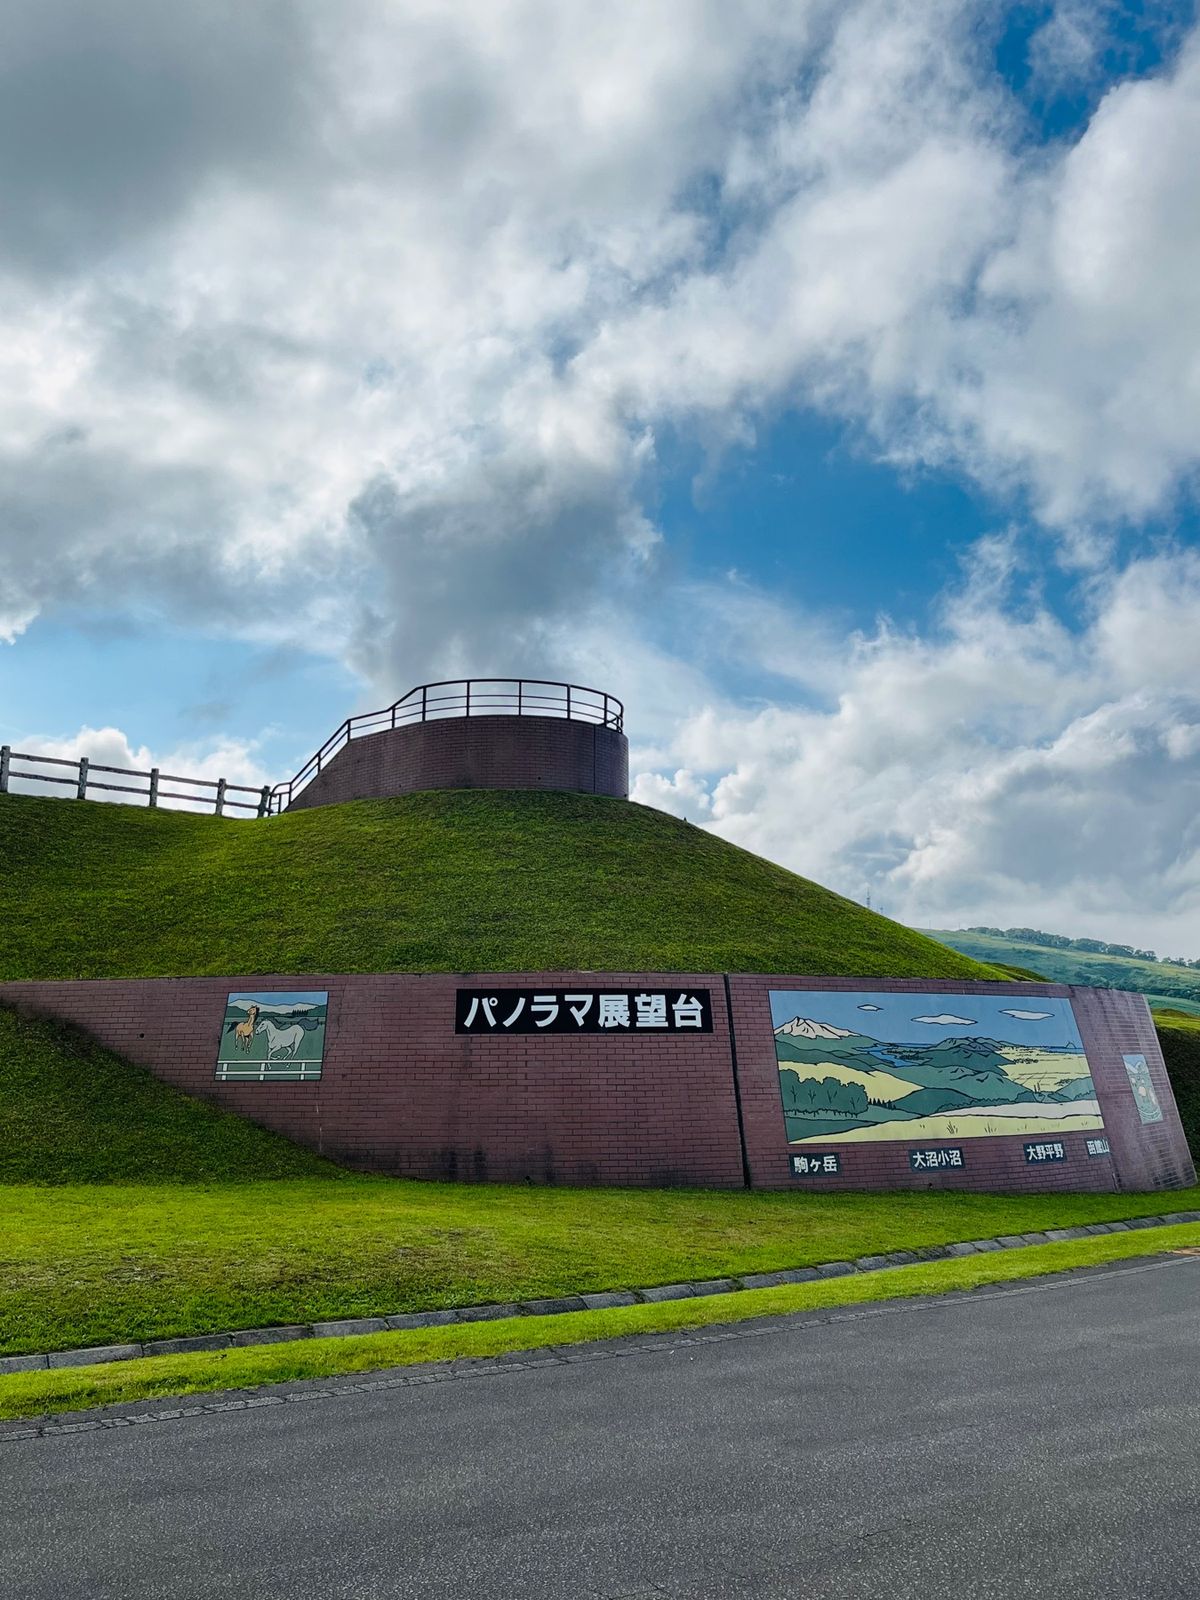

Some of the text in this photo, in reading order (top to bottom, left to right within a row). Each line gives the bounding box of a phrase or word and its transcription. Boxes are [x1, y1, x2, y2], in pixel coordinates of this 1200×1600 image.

[463, 993, 704, 1028] パノラマ展望台
[912, 1150, 962, 1169] 大沼小沼
[1026, 1143, 1064, 1161] 大野平野
